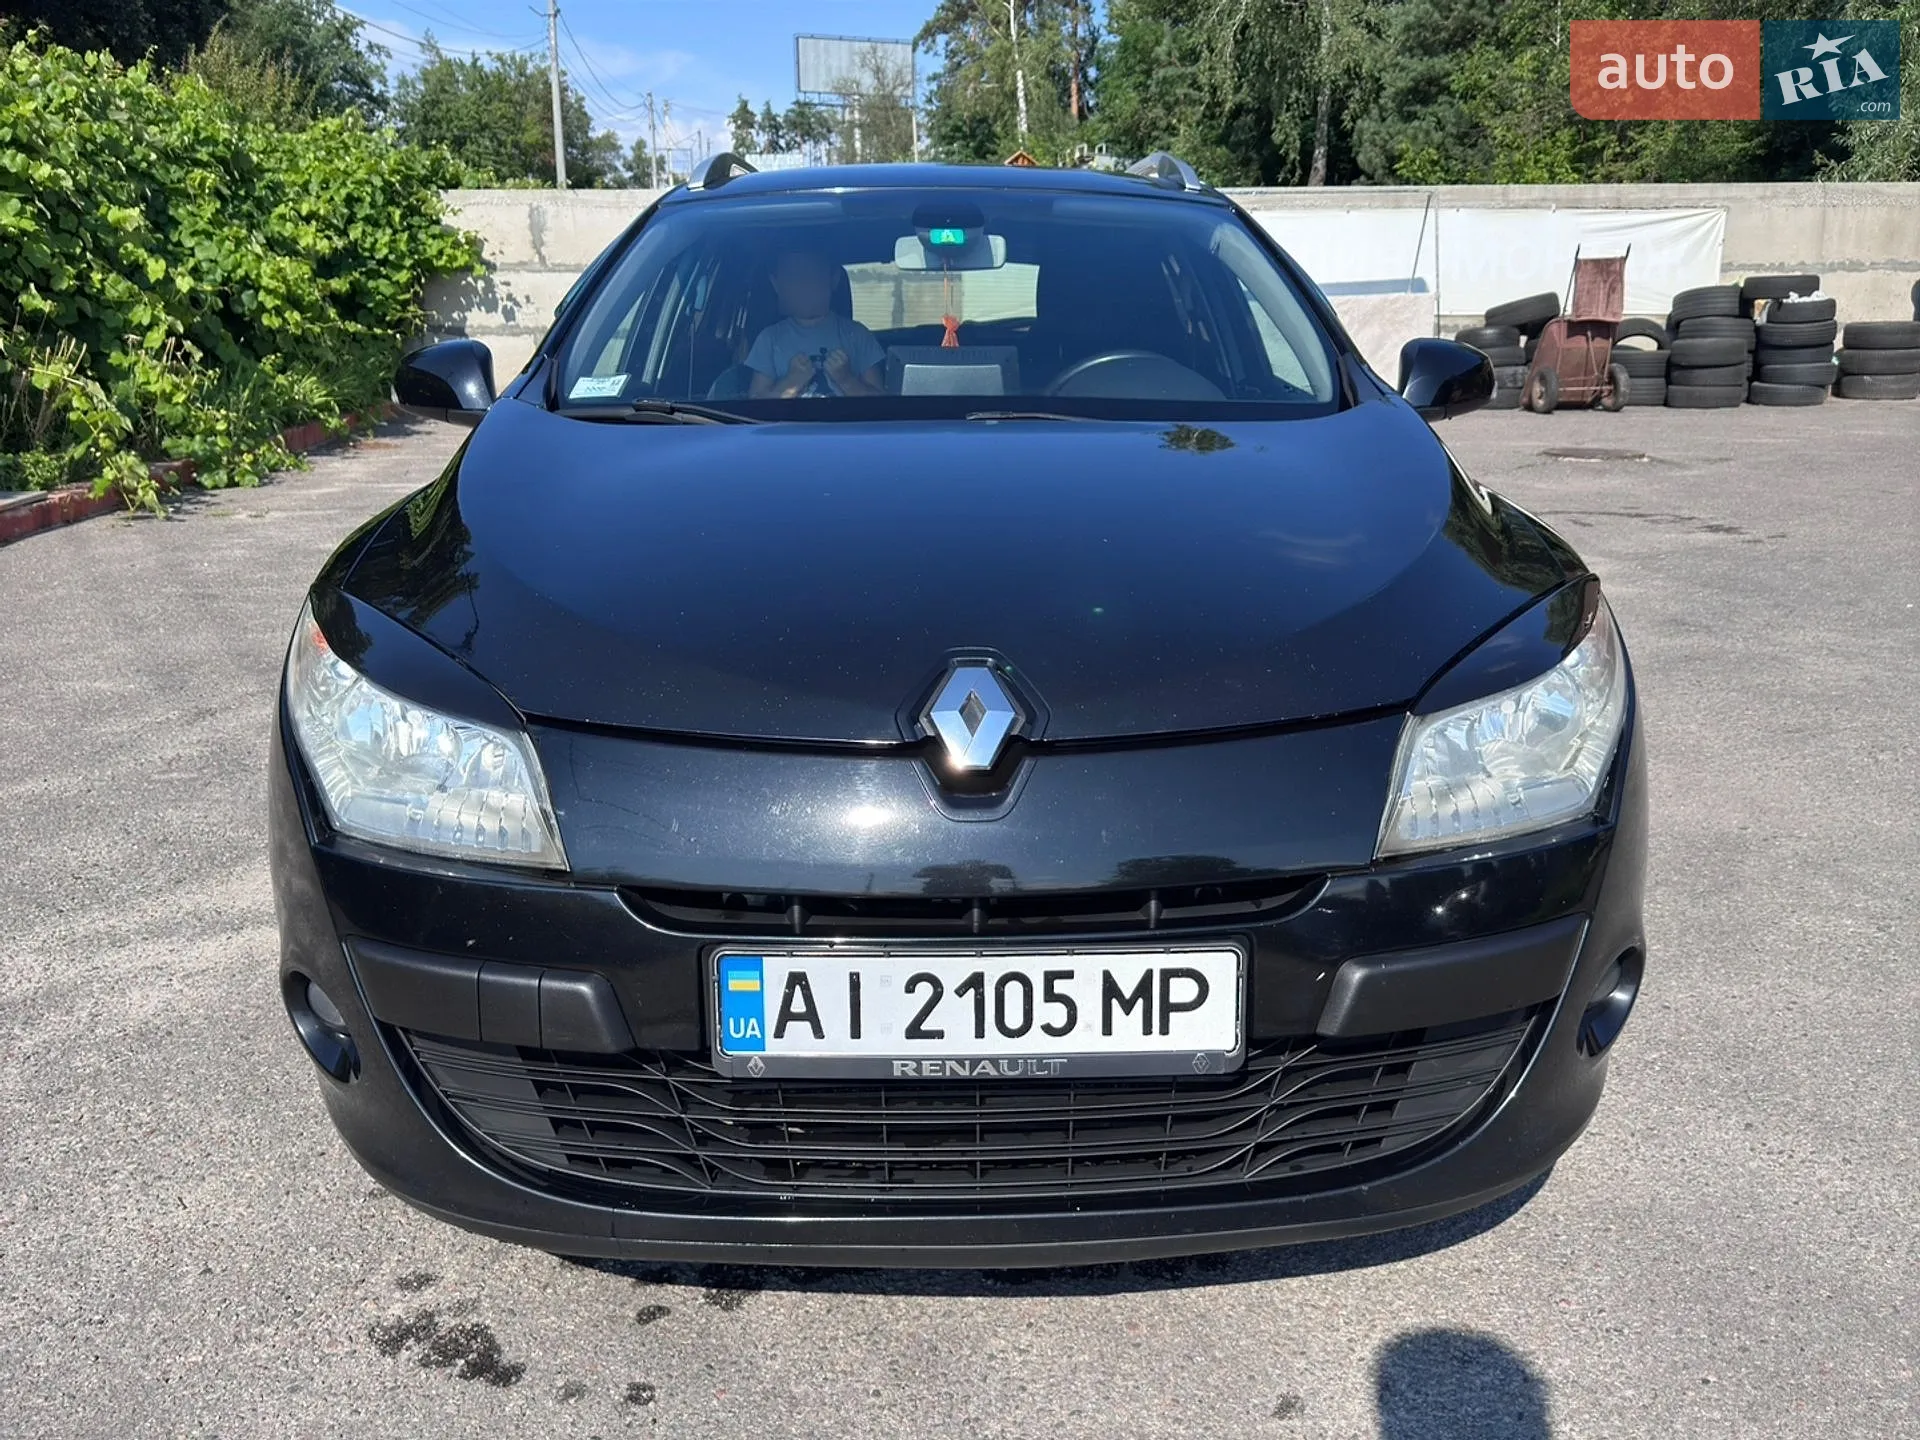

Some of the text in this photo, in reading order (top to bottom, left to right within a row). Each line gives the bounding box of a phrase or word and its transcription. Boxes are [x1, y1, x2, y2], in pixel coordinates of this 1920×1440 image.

[773, 967, 1210, 1039] AI 2105 MP
[729, 1017, 762, 1039] UA
[891, 1058, 1068, 1077] RENAULT
